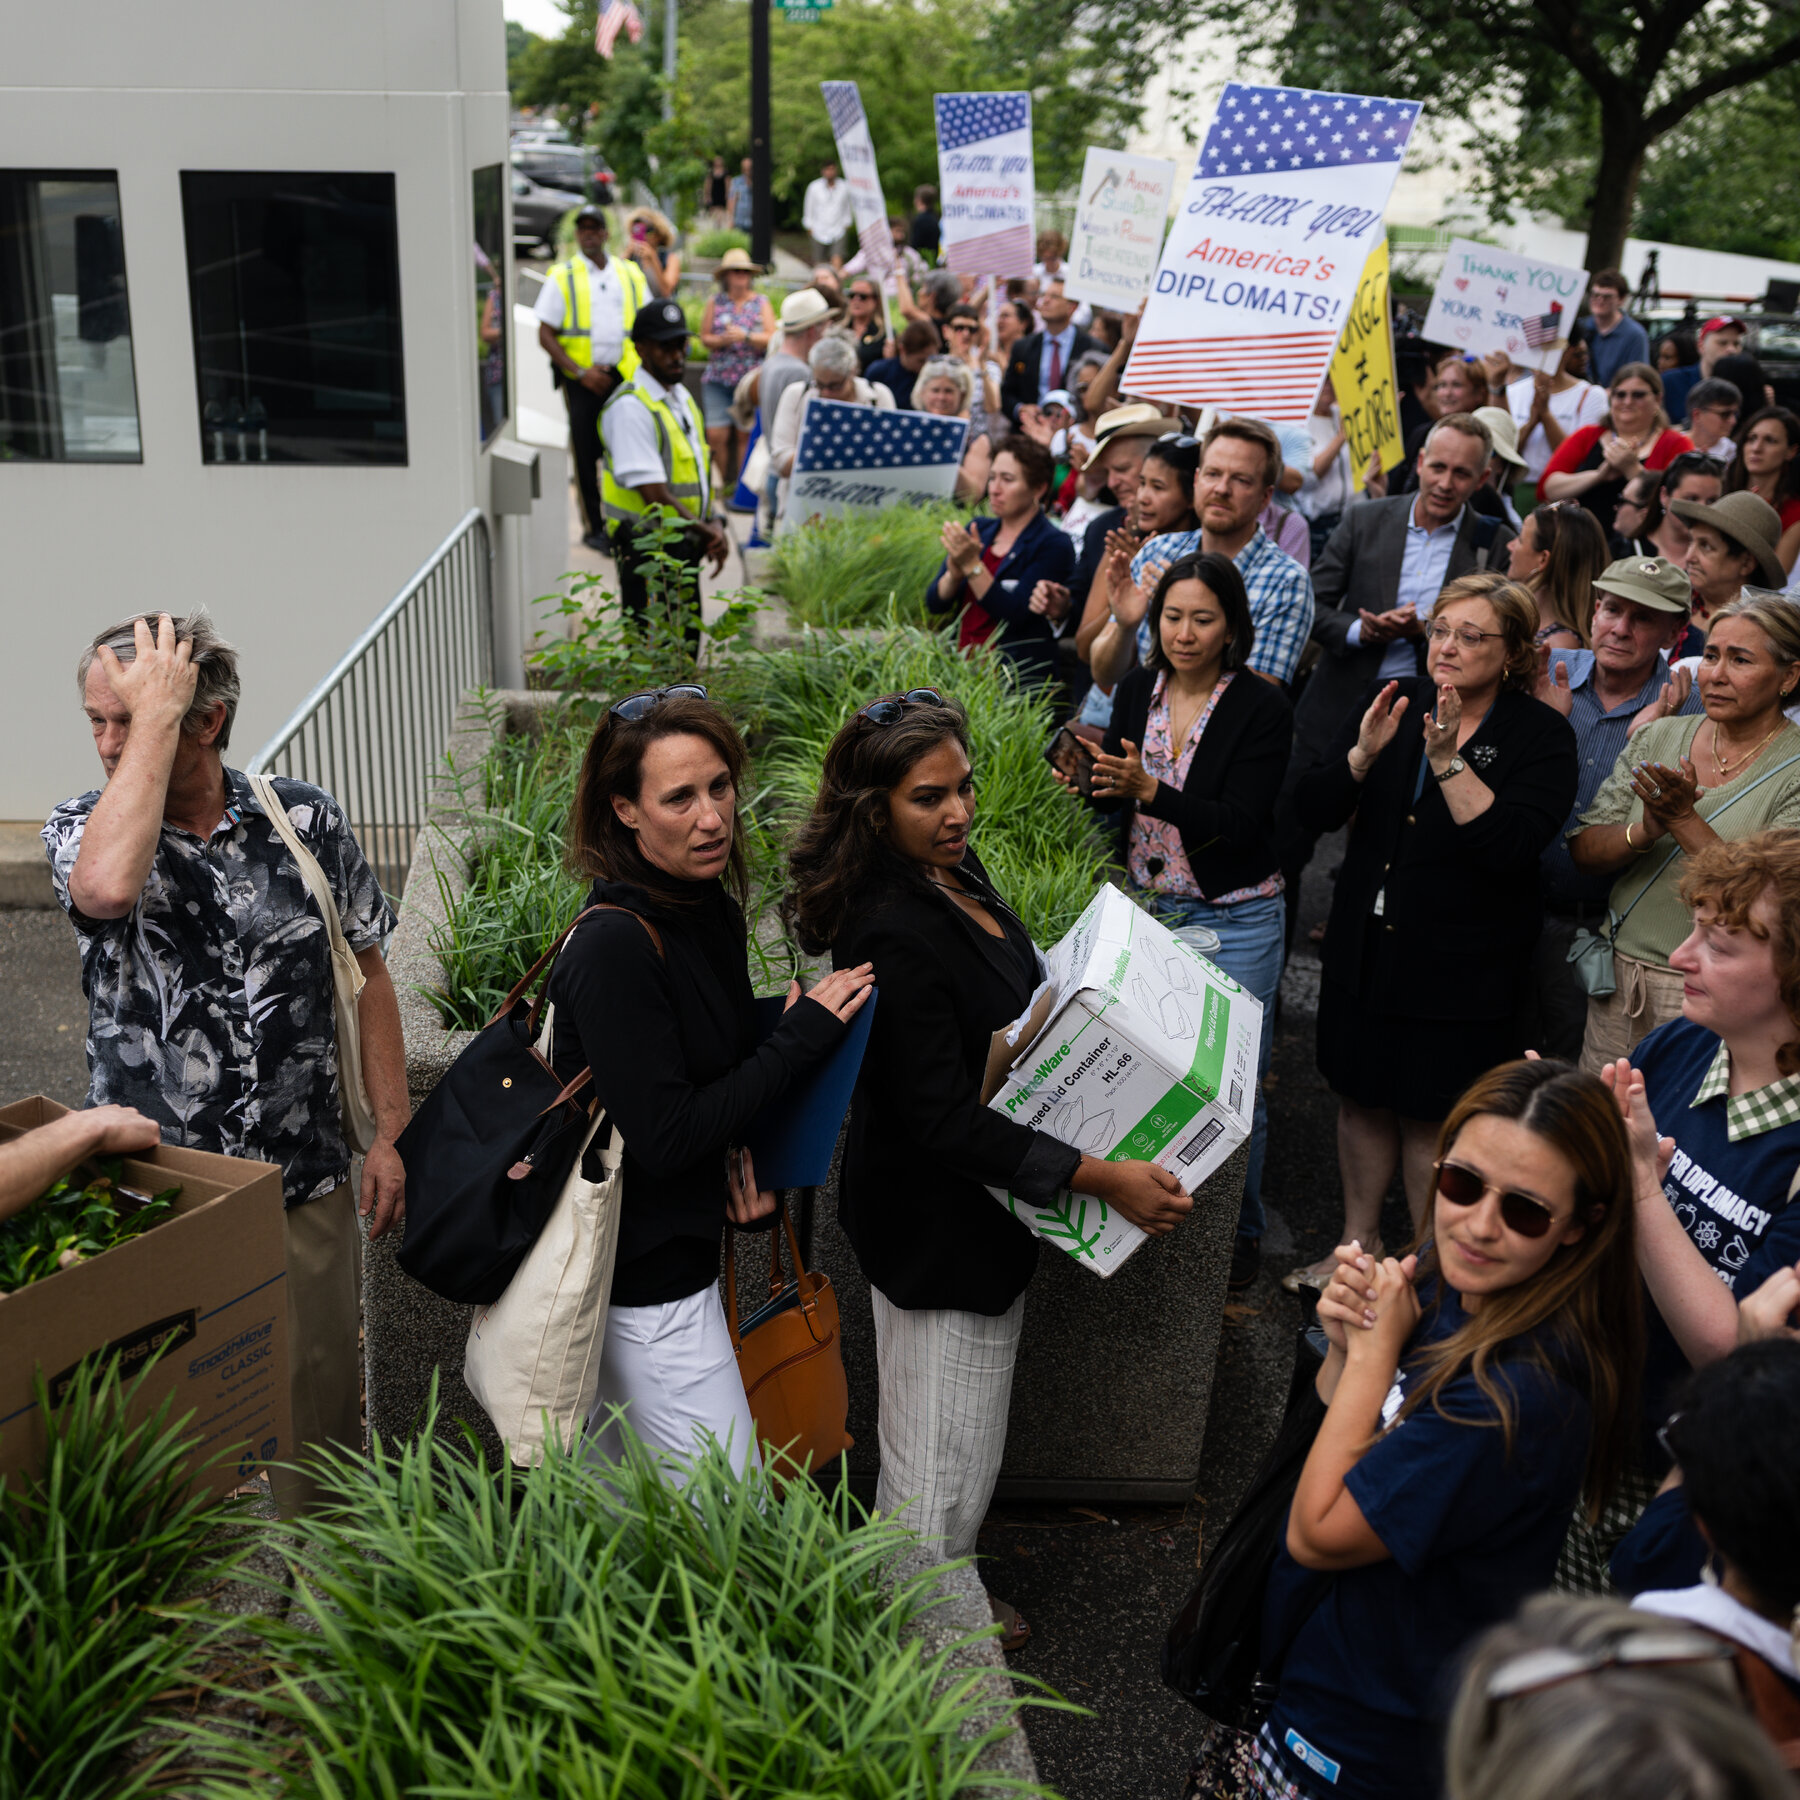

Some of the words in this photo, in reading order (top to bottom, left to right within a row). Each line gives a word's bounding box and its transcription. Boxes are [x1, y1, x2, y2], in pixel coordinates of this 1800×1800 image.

[953, 184, 1020, 198] America's
[1187, 186, 1314, 226] THANK
[1303, 204, 1382, 241] YOU
[1185, 237, 1336, 281] America's
[1458, 253, 1520, 285] THANK
[1527, 265, 1579, 297] YOU
[1156, 269, 1341, 322] DIPLOMATS!
[1439, 297, 1482, 323] YOUR
[795, 476, 897, 506] THANK
[1047, 1085, 1067, 1105] Lid
[1064, 1036, 1112, 1086] Container
[1101, 1052, 1132, 1084] HL-66
[1669, 1149, 1692, 1181] FOR
[1681, 1164, 1772, 1236] DIPLOMACY
[221, 1342, 273, 1381] CLASSIC
